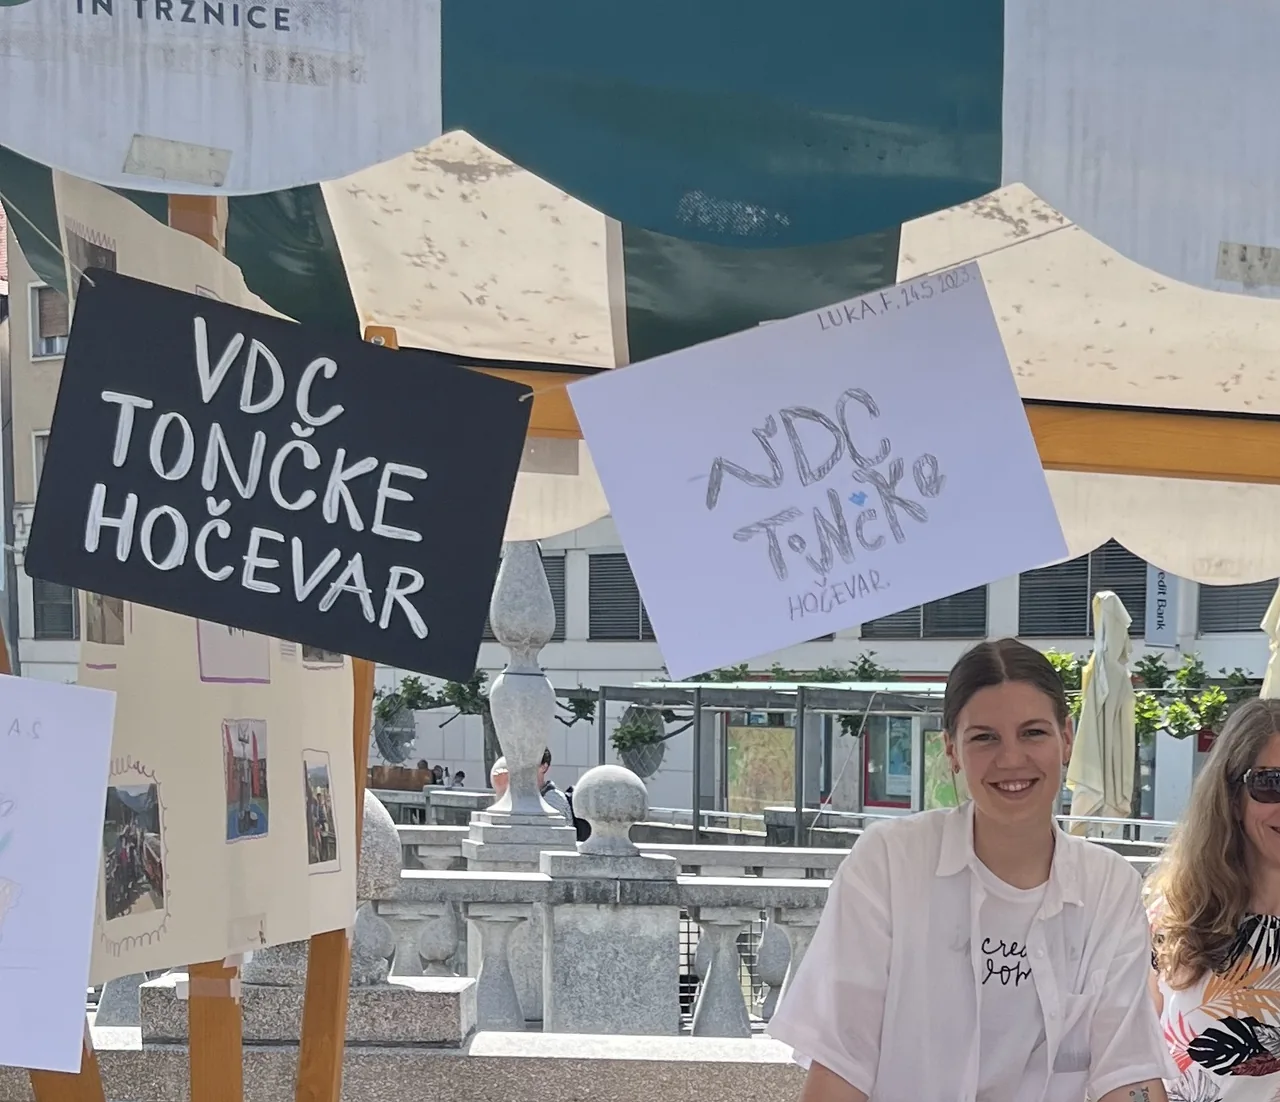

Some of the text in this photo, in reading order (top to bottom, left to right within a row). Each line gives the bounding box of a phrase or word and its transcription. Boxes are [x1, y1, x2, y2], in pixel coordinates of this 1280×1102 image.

[101, 389, 428, 542] TONČKE
[84, 483, 429, 639] HOČEVAR
[1156, 598, 1167, 631] Bank
